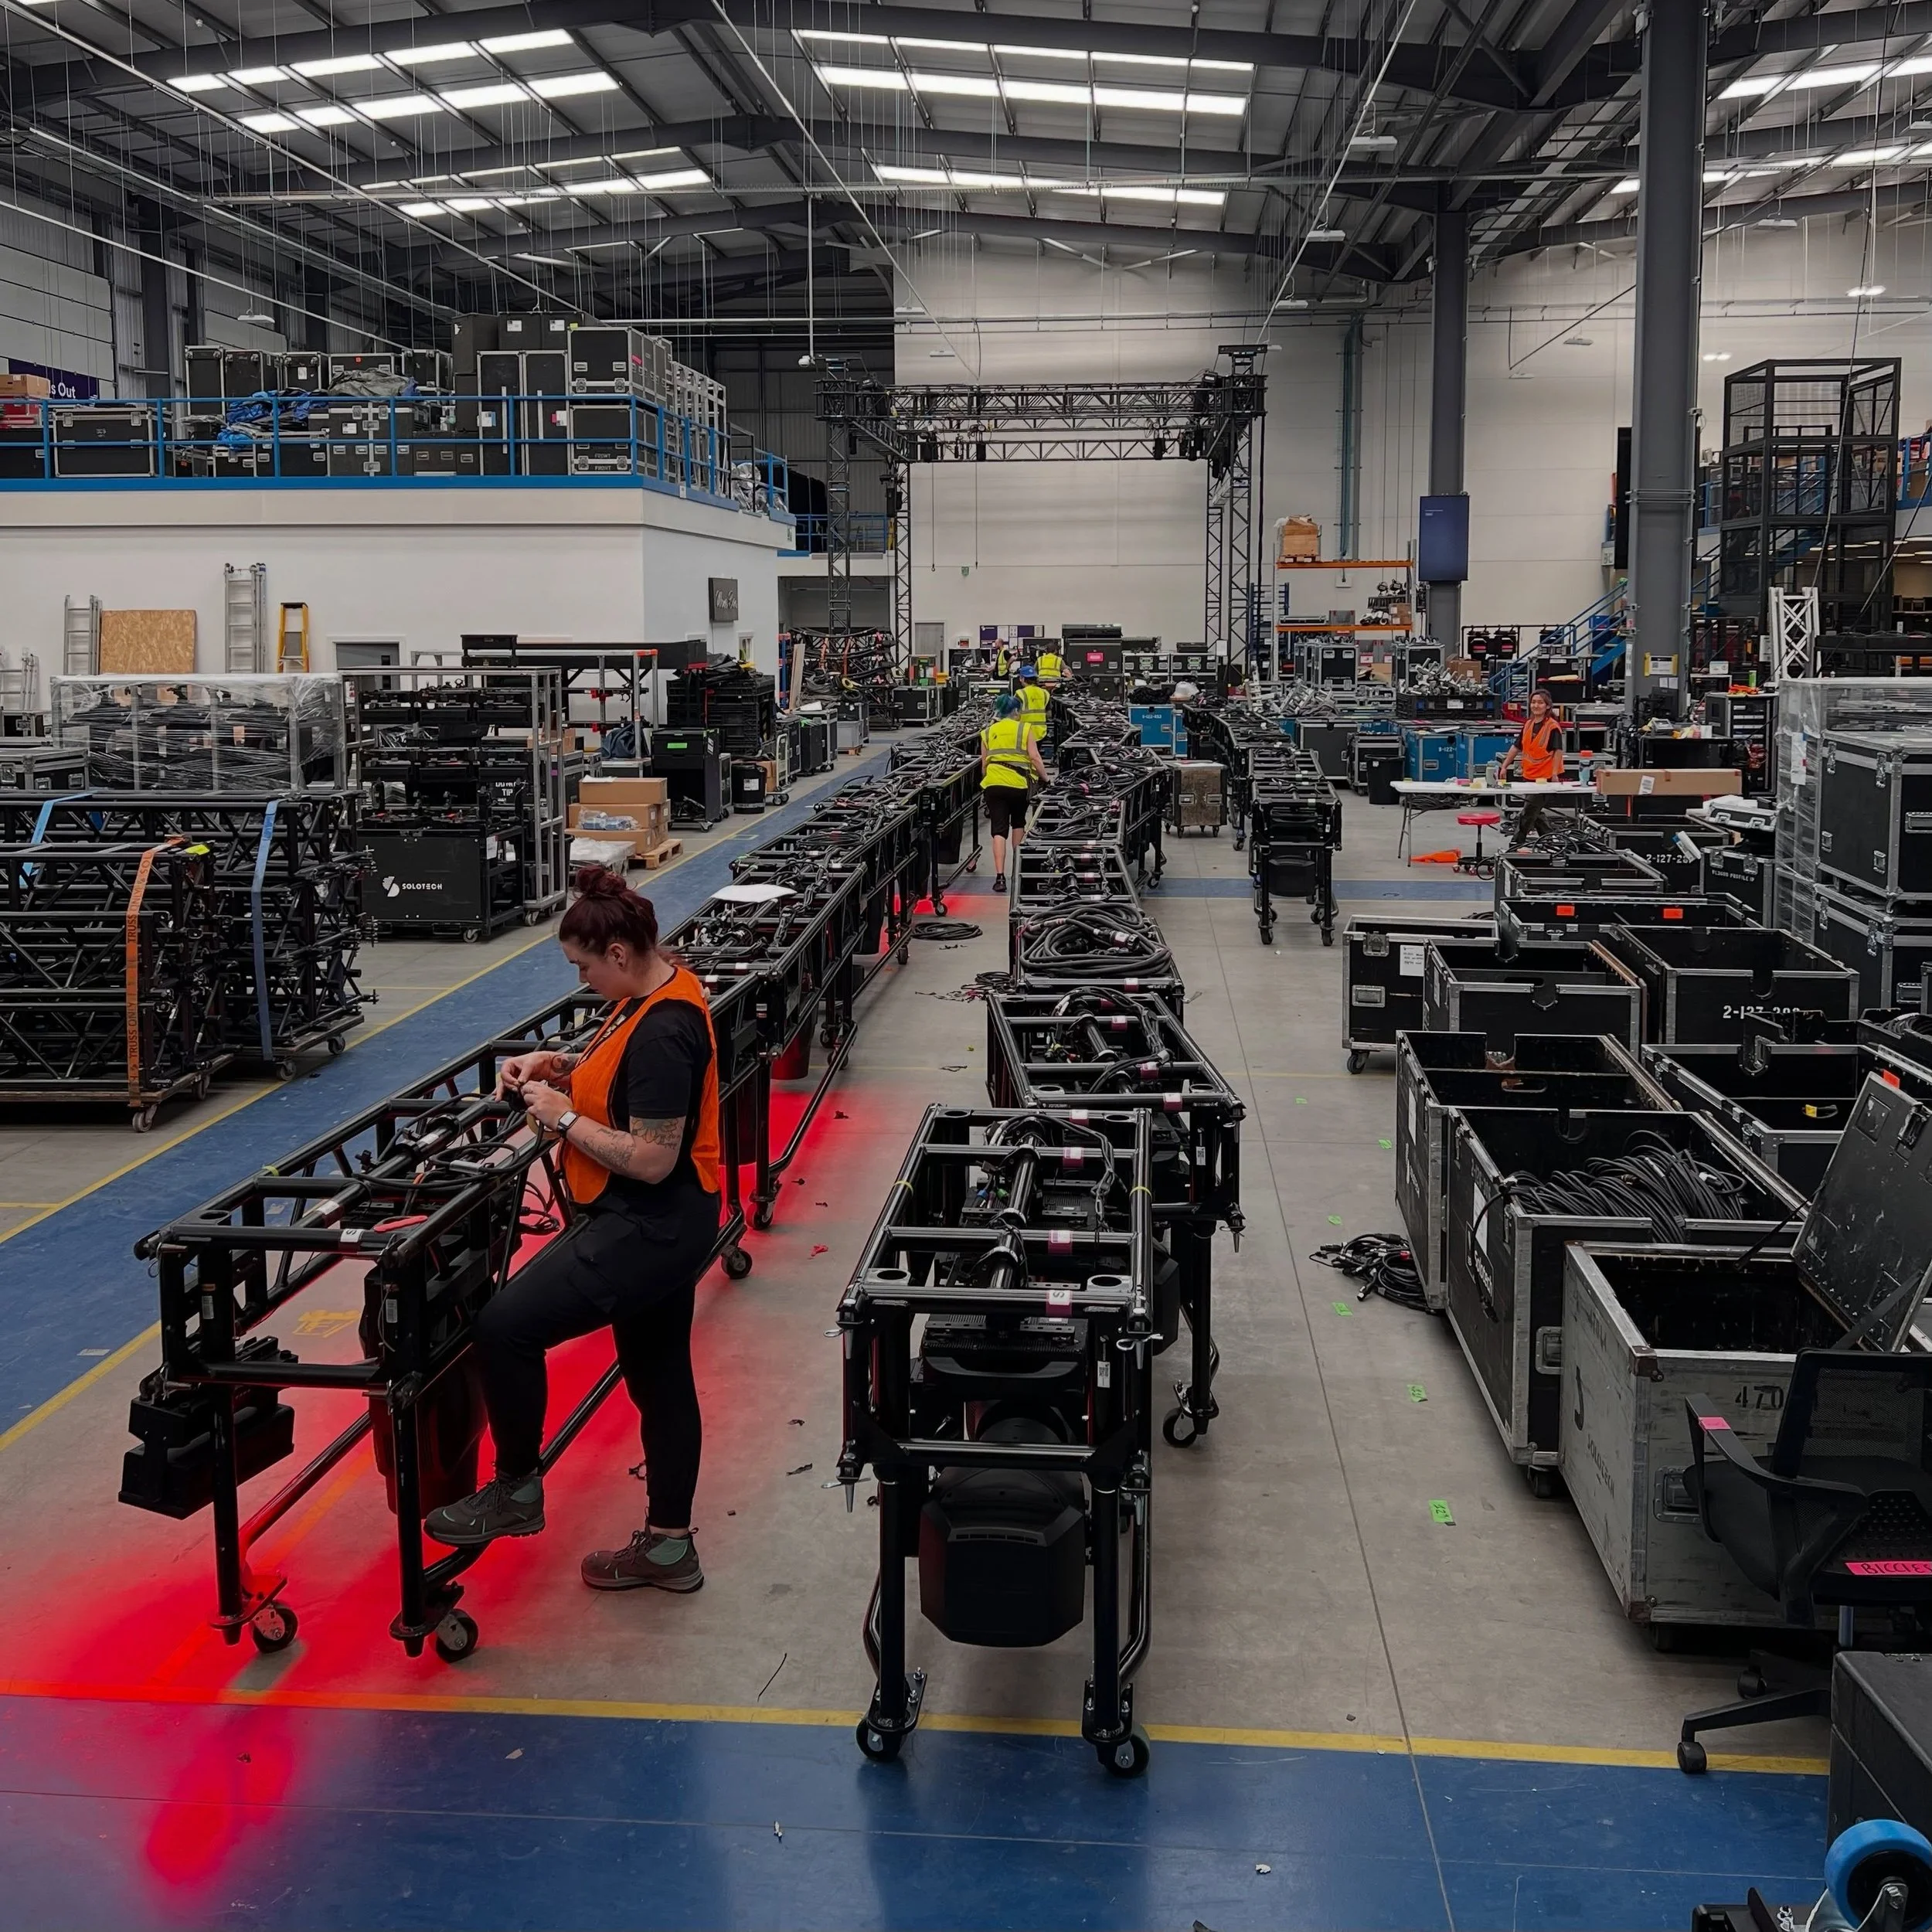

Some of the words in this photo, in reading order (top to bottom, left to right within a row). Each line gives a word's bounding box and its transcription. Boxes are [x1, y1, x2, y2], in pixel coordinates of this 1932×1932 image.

[58, 382, 76, 399] Out
[1646, 853, 1691, 864] 2-127-28
[128, 914, 138, 944] TRUSS
[128, 1002, 138, 1027] ONLY
[128, 1029, 138, 1059] TRUSS
